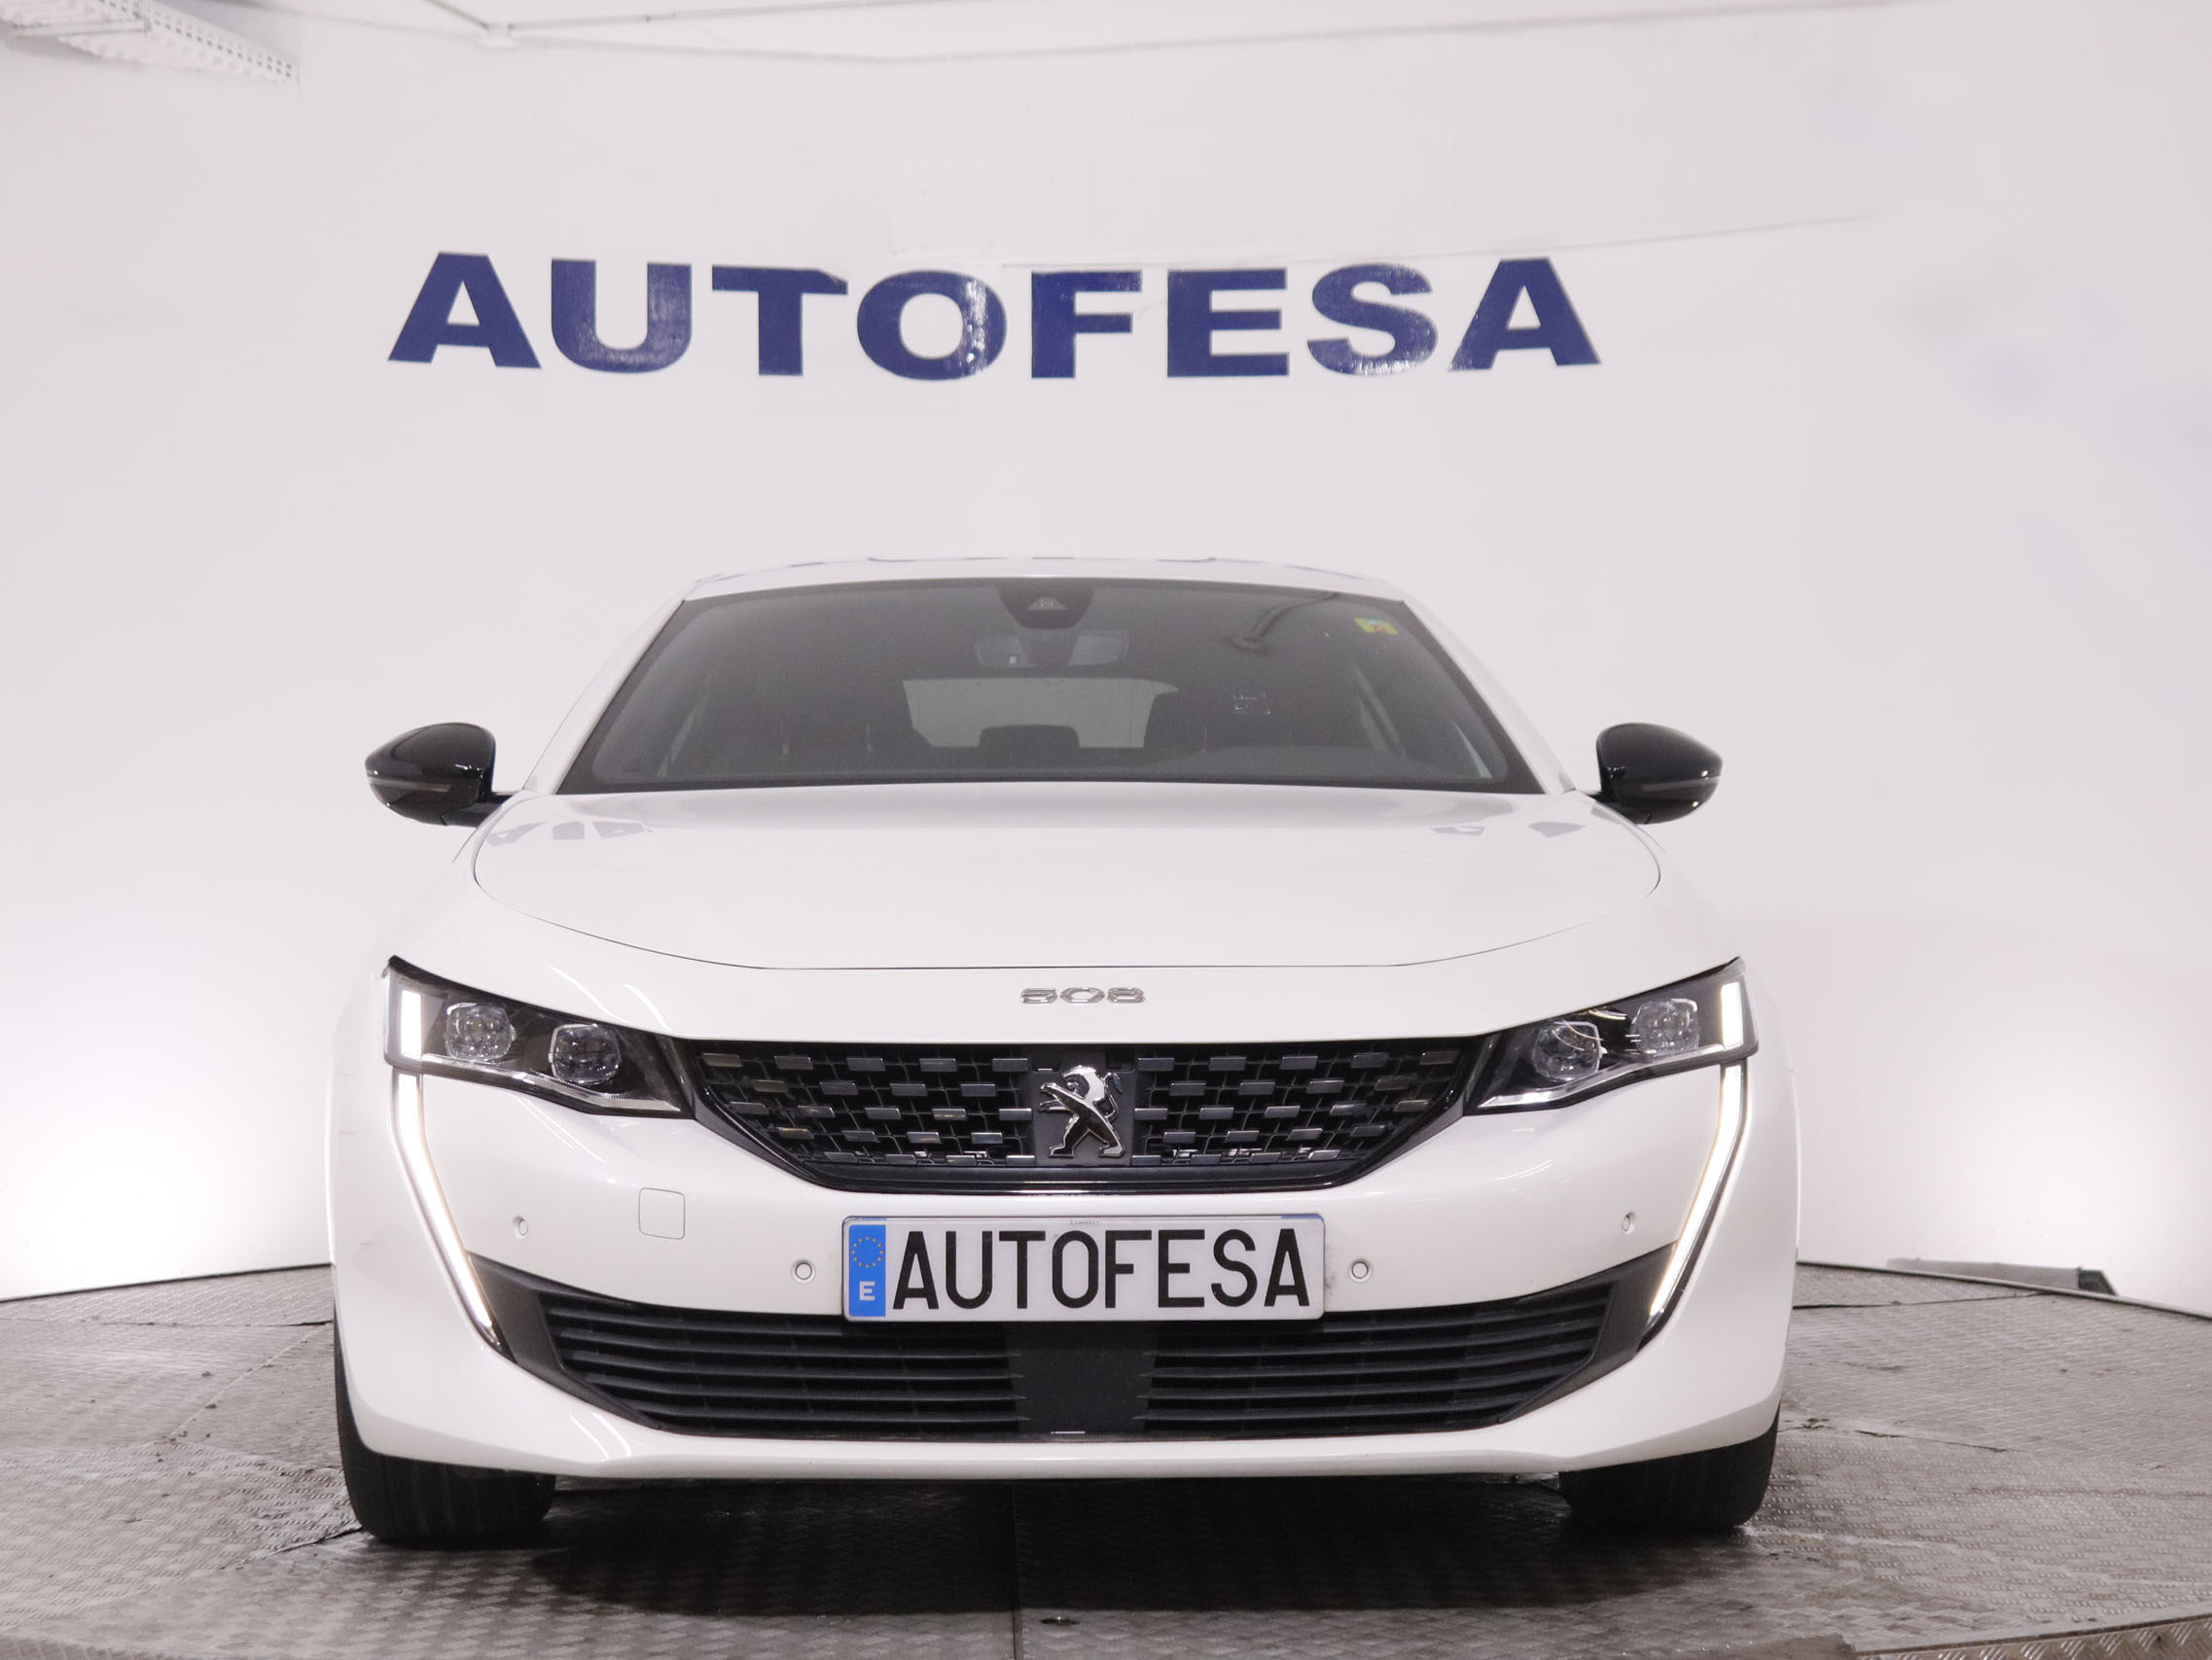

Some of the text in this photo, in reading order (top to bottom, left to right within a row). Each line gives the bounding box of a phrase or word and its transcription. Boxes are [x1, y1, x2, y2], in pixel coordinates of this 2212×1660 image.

[388, 252, 1602, 381] AUTOFESA
[1020, 986, 1146, 1005] 508
[858, 1281, 875, 1301] E
[892, 1228, 1310, 1310] AUTOFESA
